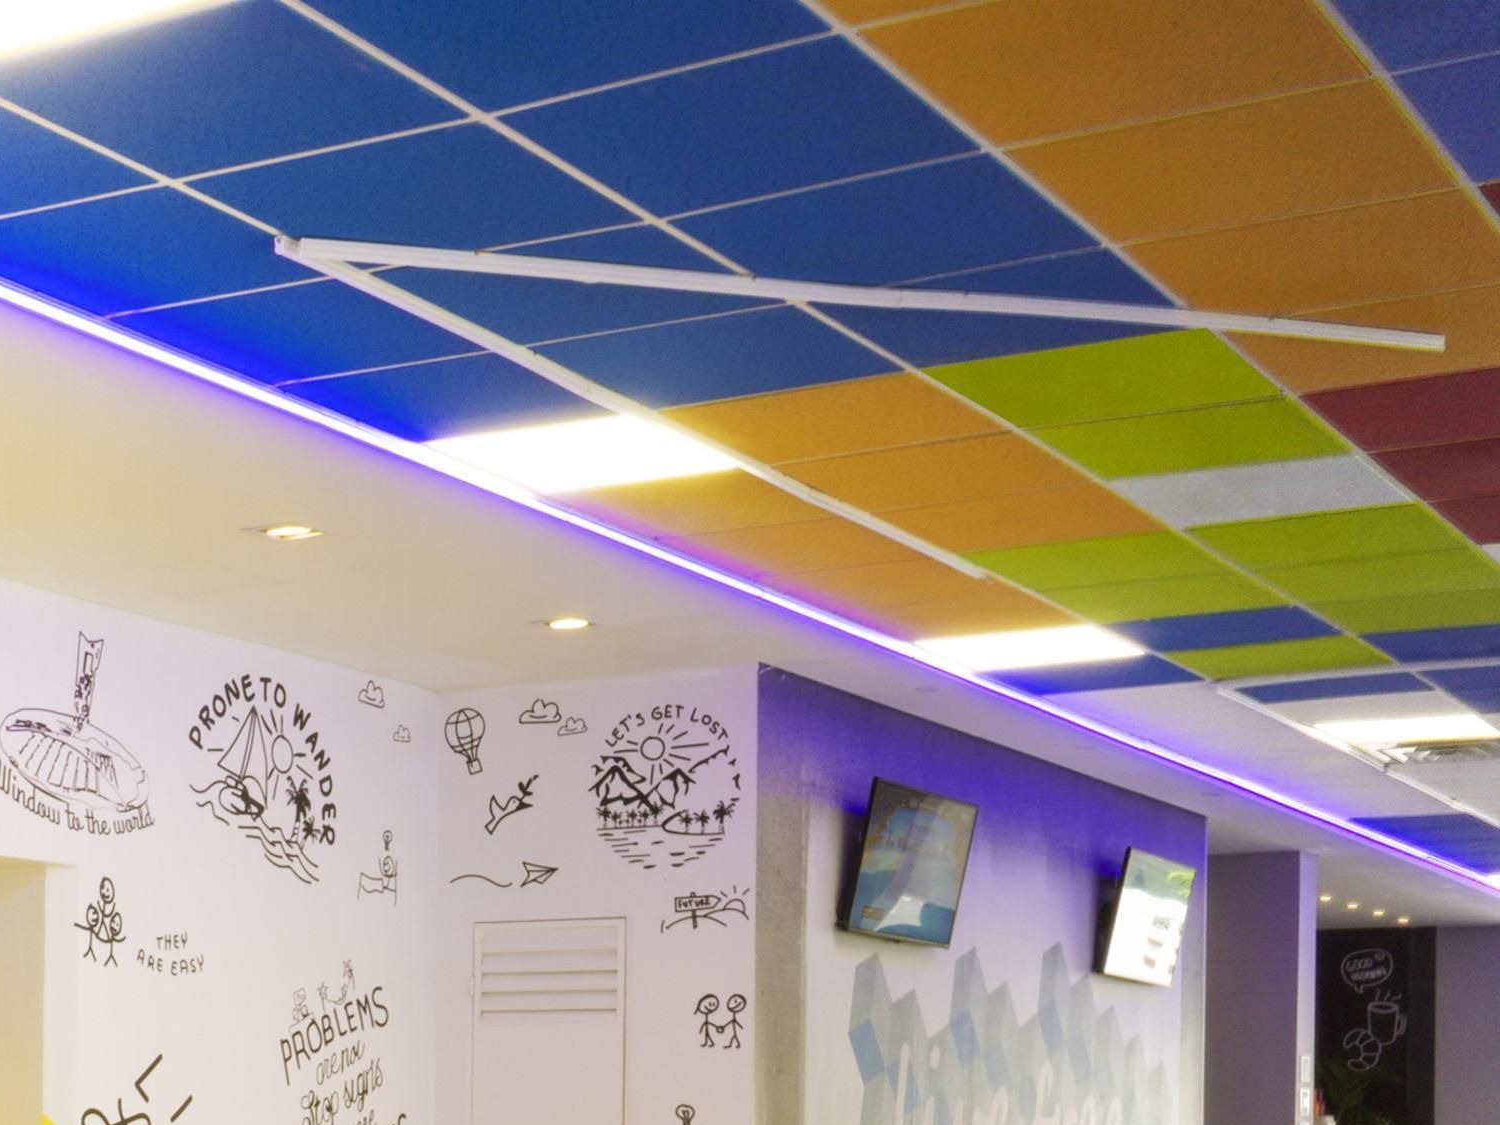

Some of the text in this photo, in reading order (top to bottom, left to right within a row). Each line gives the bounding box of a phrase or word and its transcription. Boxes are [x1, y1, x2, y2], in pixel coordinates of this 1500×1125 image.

[605, 704, 729, 748] LET'S GET LOST
[188, 674, 337, 846] PRONE TO WANDER
[66, 804, 84, 831] to
[86, 808, 111, 836] the
[113, 802, 155, 835] world
[155, 932, 189, 951] THEY
[136, 949, 205, 976] ARE EASY
[280, 986, 389, 1086] PROBLEMS
[316, 1052, 341, 1085] are
[343, 1058, 384, 1112] signs
